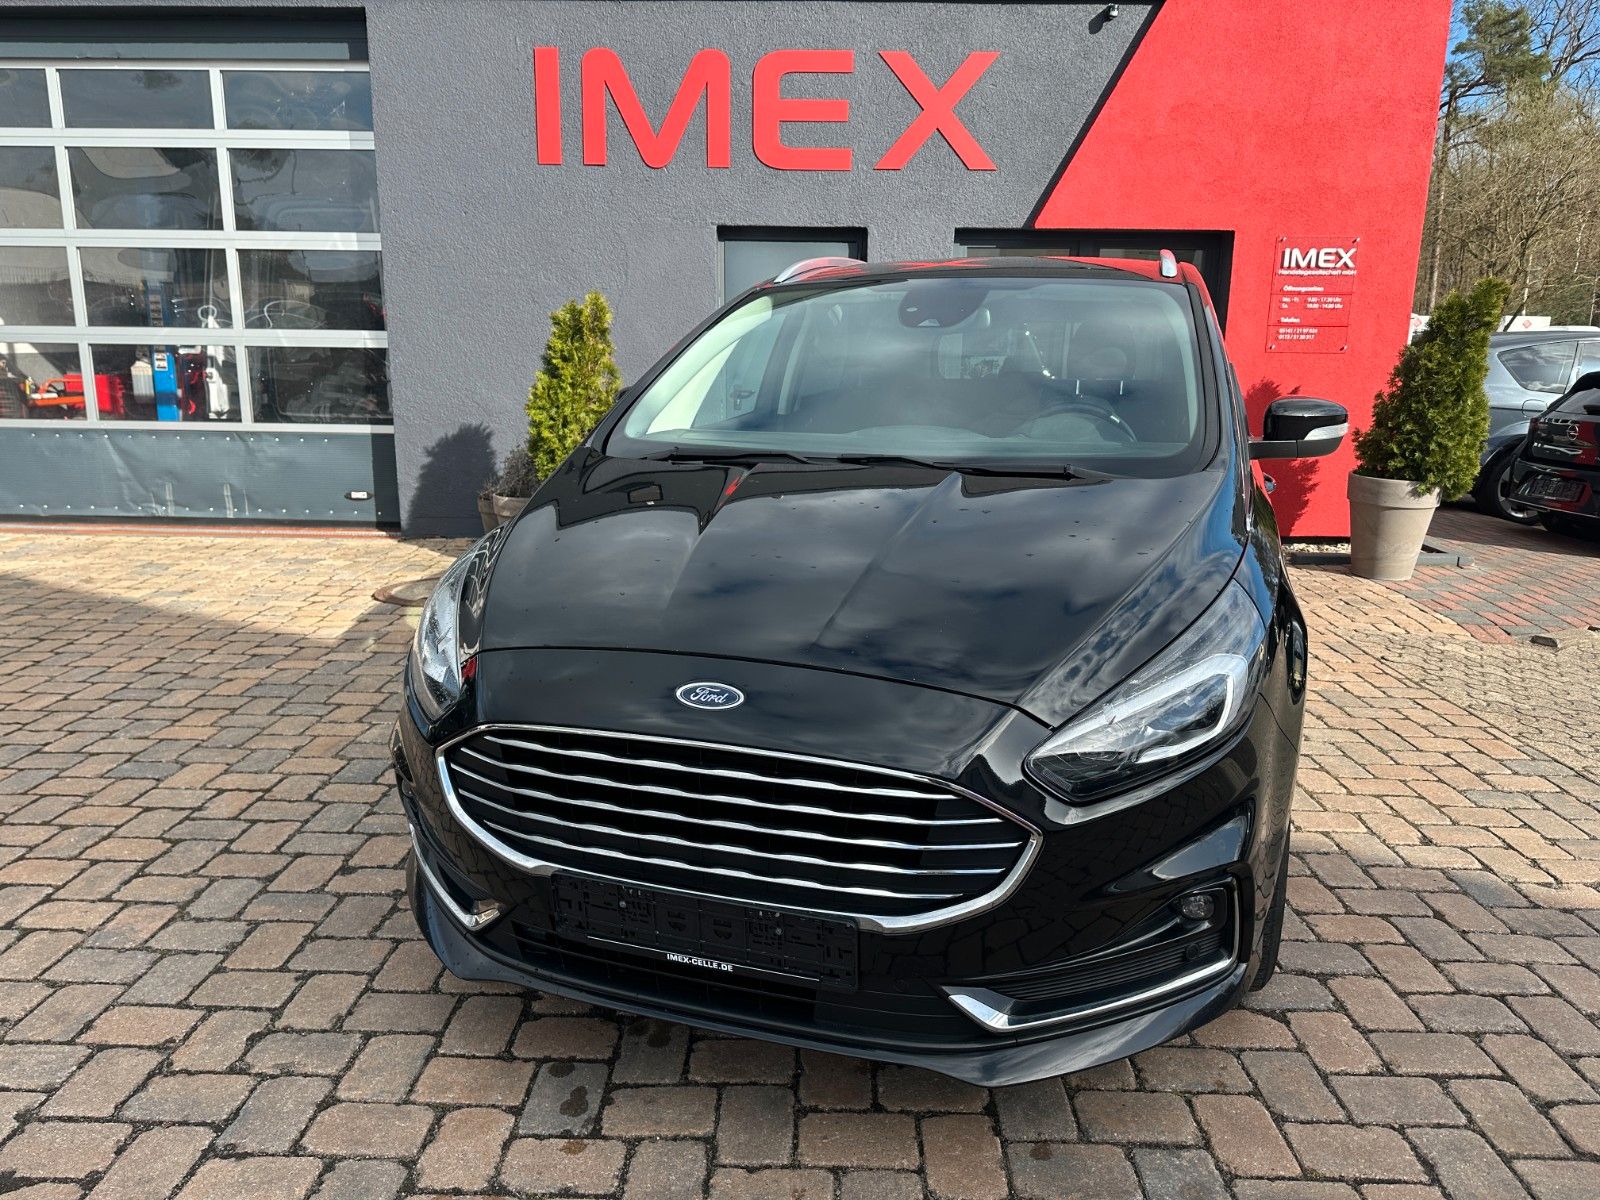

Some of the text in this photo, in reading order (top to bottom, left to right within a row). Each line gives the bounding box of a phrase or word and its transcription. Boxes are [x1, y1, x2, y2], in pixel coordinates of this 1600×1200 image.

[533, 46, 1000, 171] IMEX
[1282, 247, 1357, 268] IMEX
[690, 686, 729, 703] Ford
[666, 953, 734, 972] IMEX-CELLE.DE
